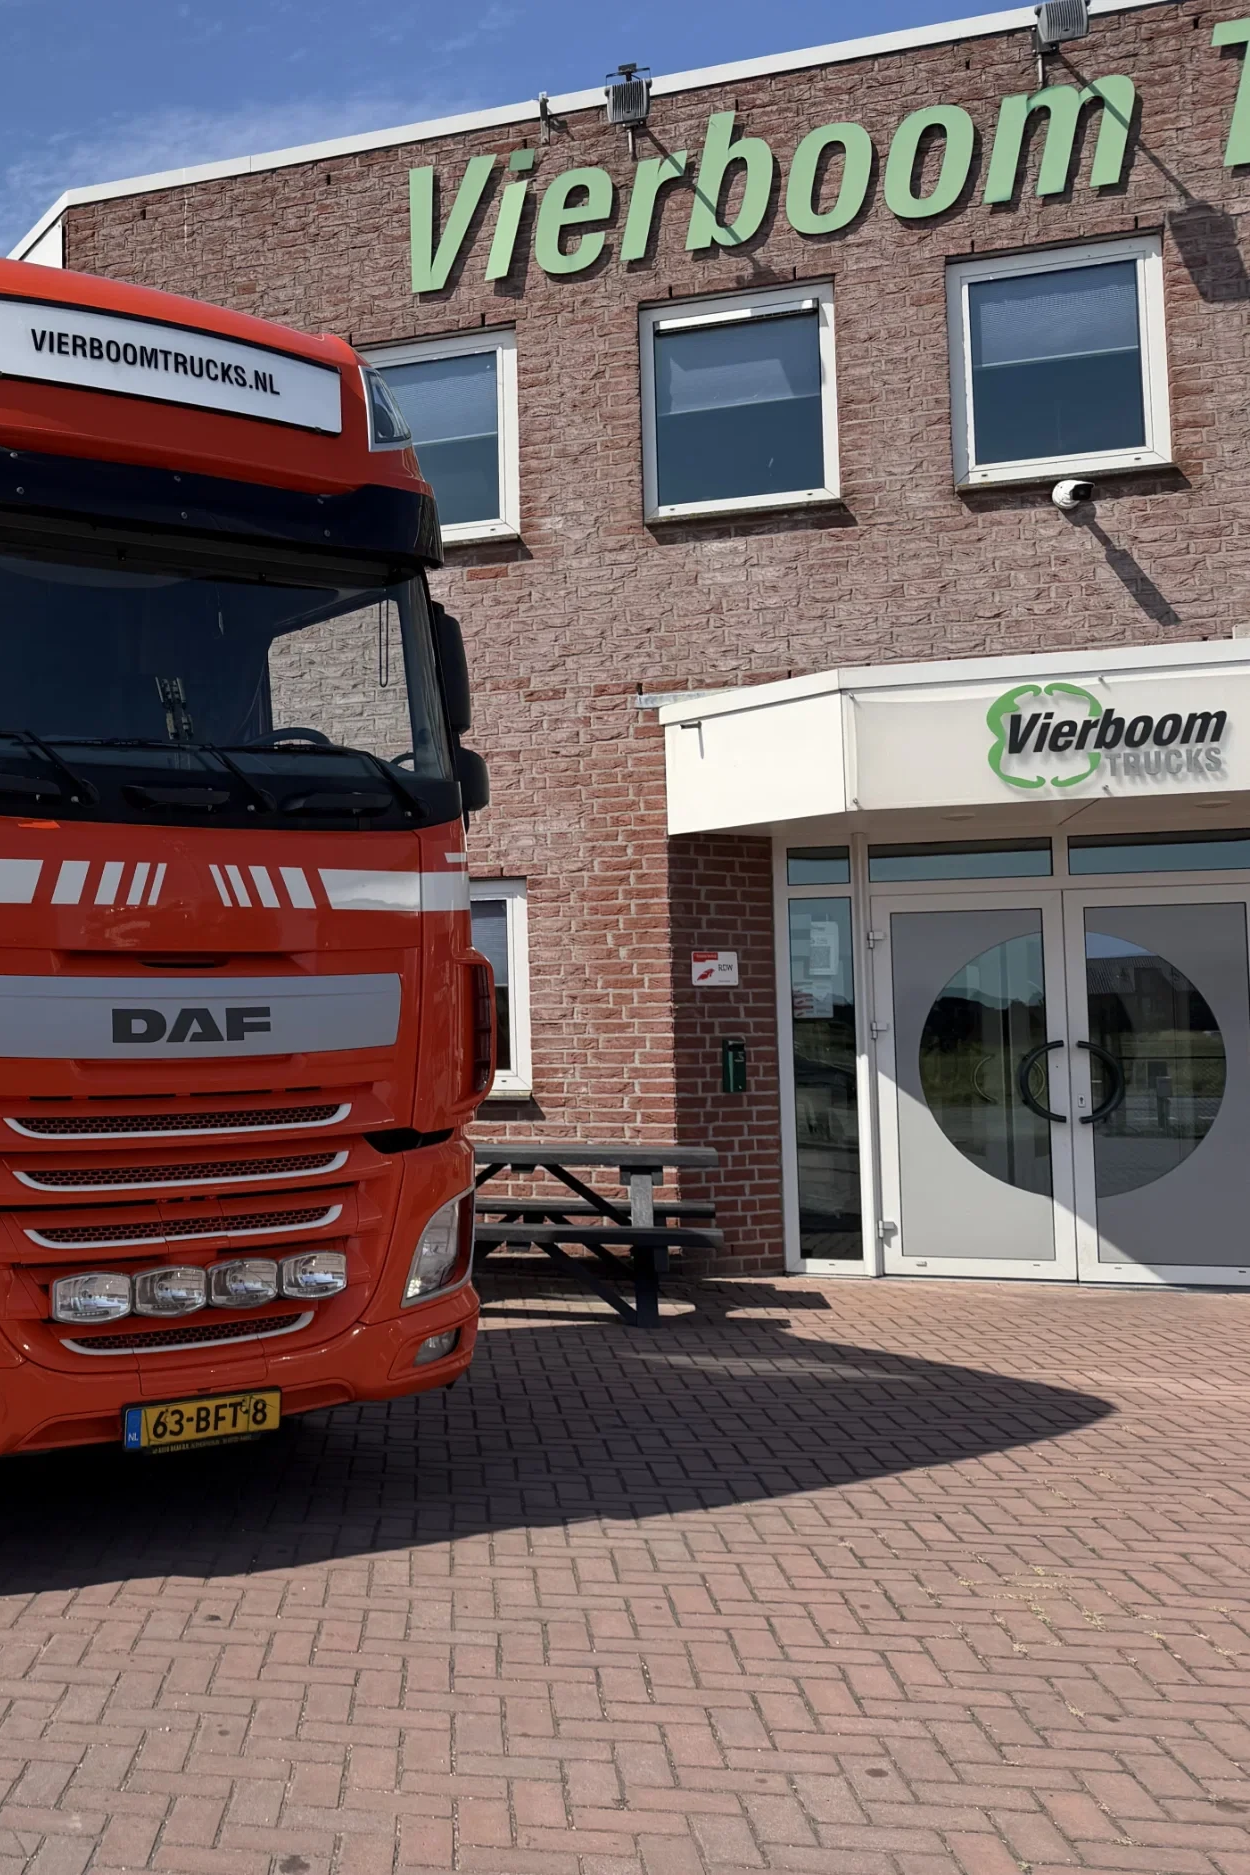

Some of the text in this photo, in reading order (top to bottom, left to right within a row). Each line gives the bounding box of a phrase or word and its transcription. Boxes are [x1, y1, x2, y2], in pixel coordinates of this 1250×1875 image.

[408, 74, 1136, 293] Vierboom
[30, 328, 281, 396] VIERBOOMTRUCKS.NL
[1008, 708, 1227, 754] Vierboom
[1105, 747, 1222, 777] TRUCKS
[111, 1006, 271, 1043] DAF
[127, 1432, 139, 1443] NL
